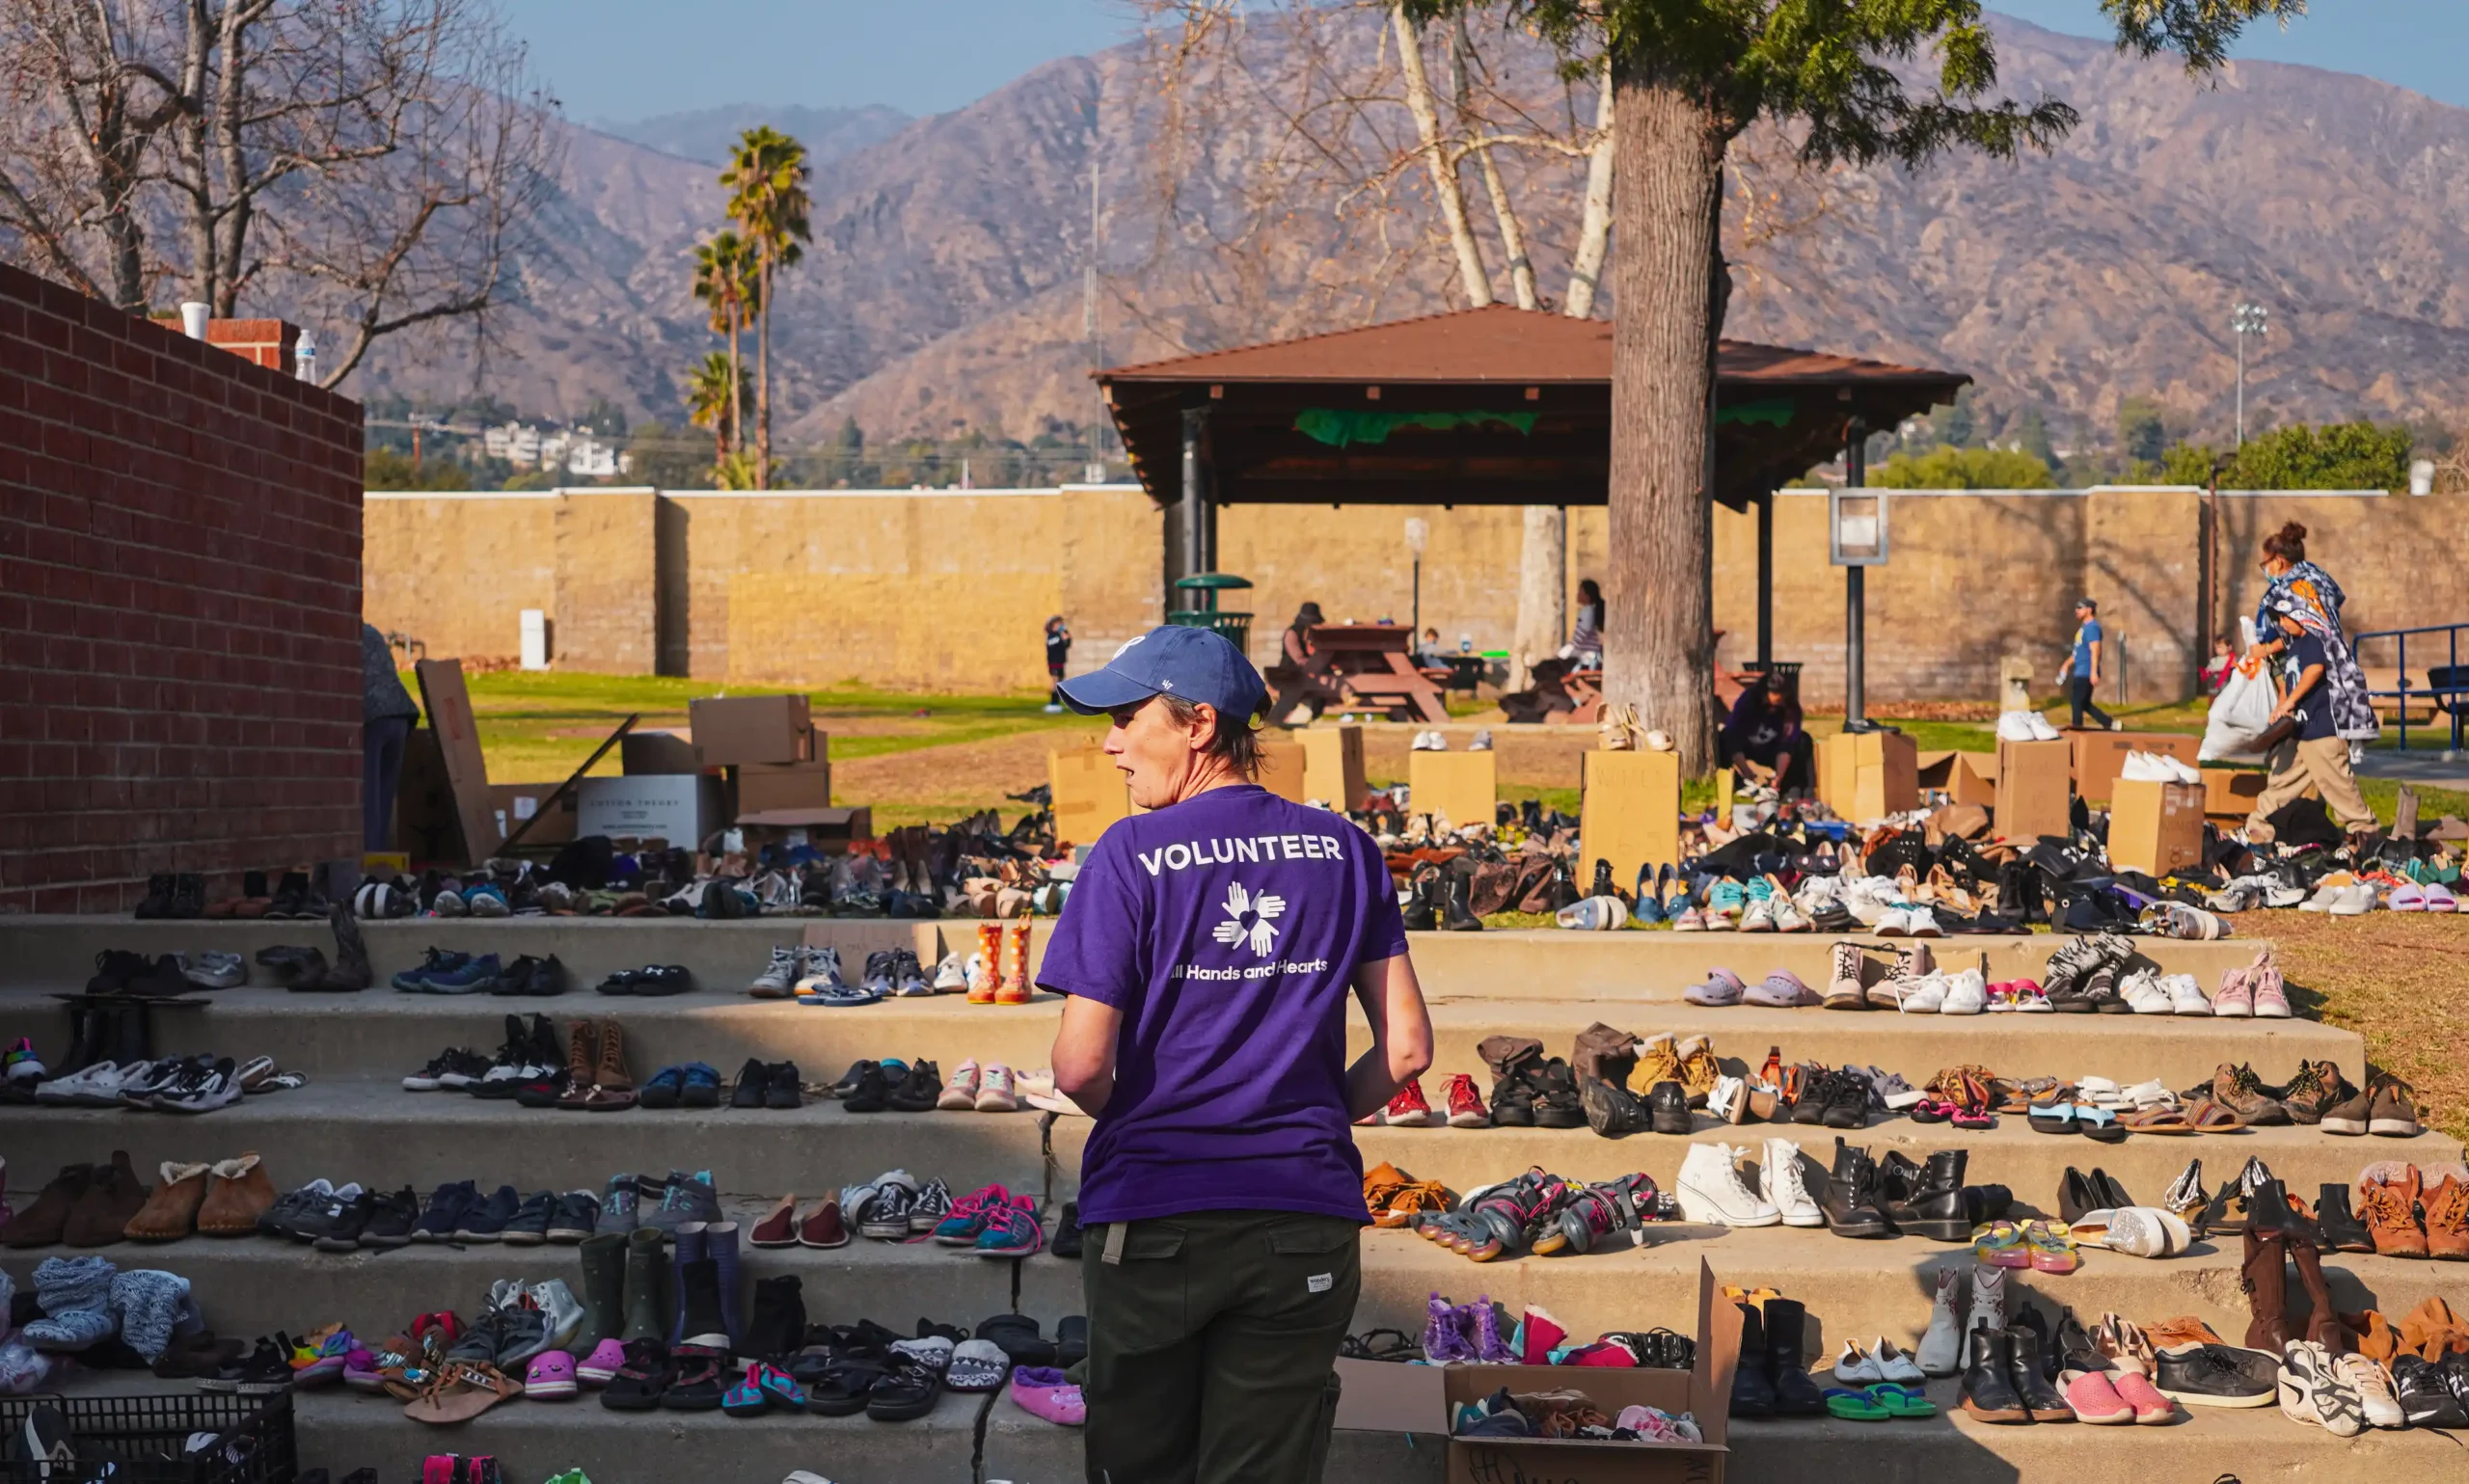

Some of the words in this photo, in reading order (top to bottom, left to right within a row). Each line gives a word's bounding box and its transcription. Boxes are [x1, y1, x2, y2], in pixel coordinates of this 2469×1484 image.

[1138, 835, 1343, 876] VOLUNTEER
[1186, 964, 1241, 981] Hands
[1243, 962, 1275, 979] and
[1276, 958, 1328, 974] Hearts
